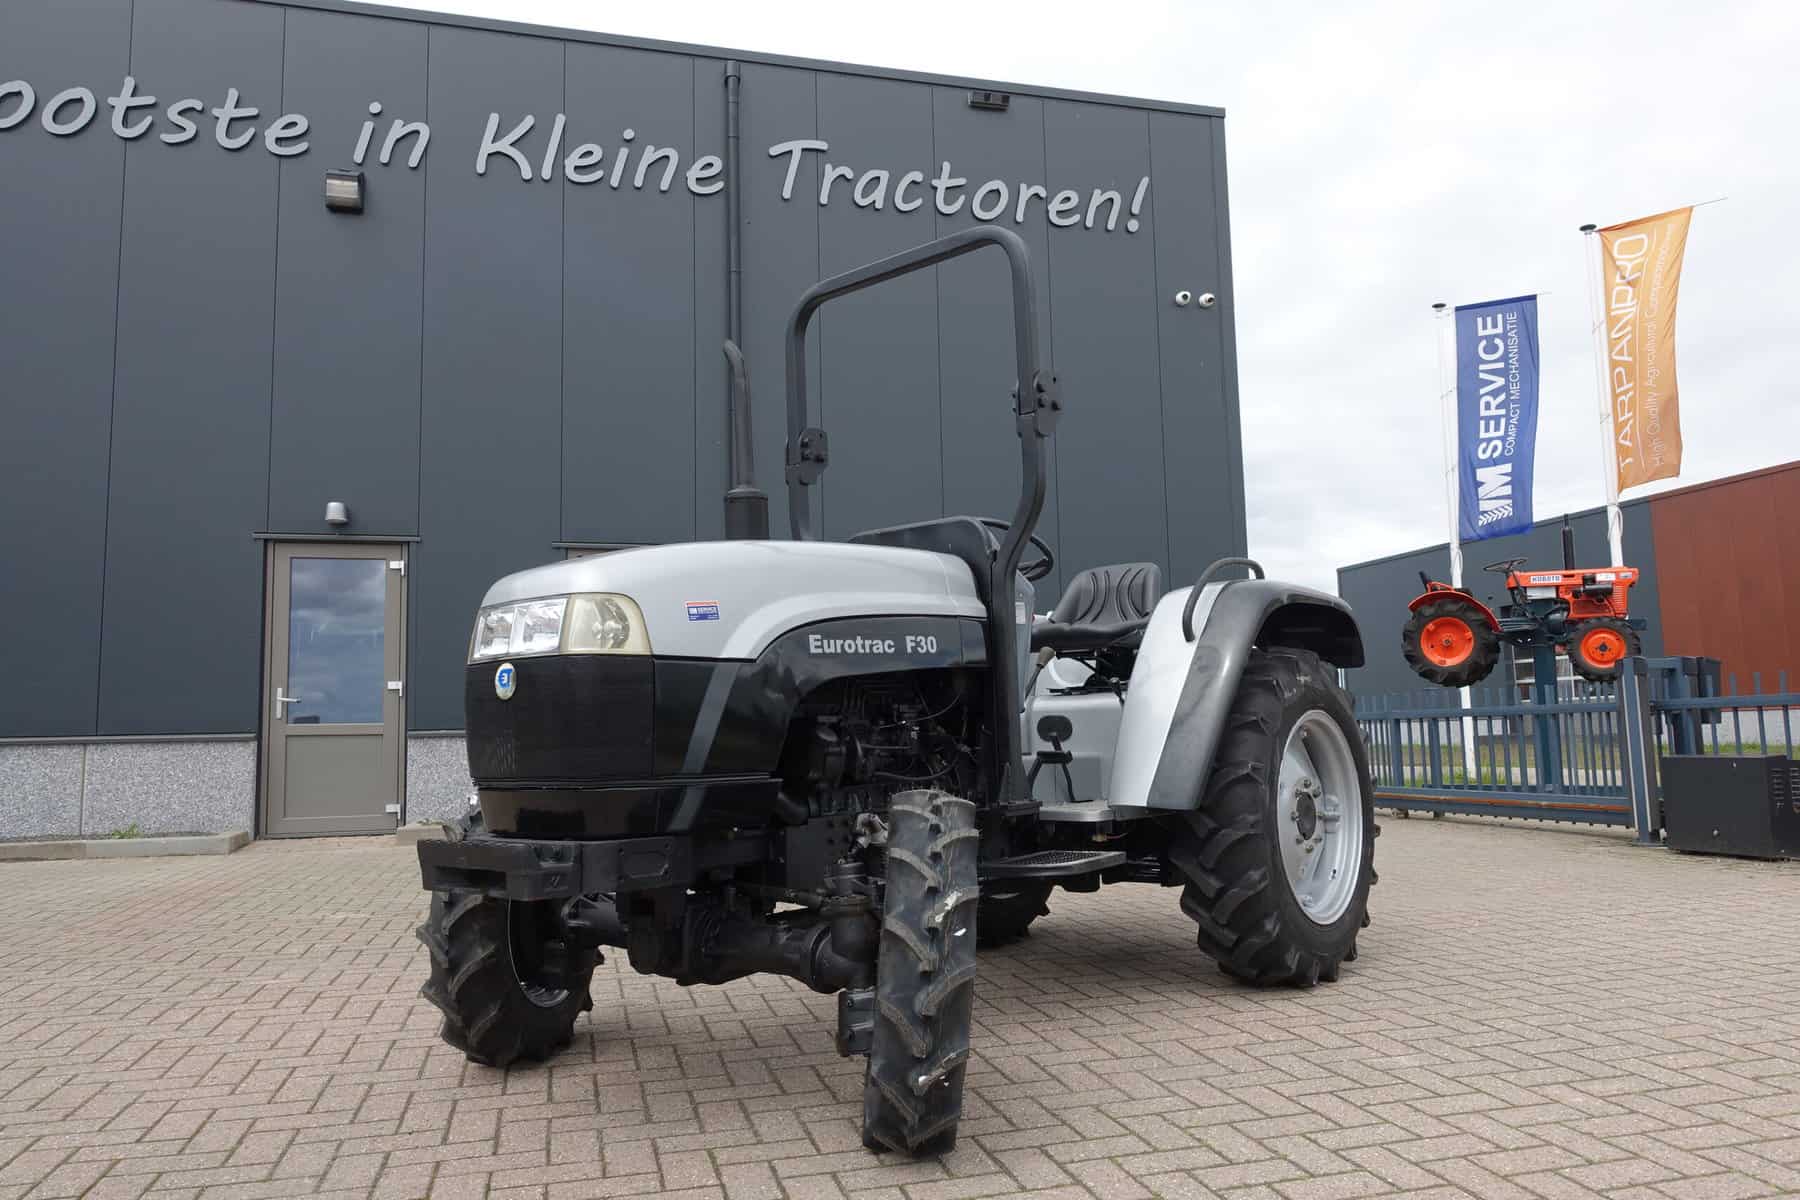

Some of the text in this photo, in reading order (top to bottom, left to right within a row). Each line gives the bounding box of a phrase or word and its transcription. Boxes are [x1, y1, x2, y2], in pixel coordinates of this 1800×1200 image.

[352, 102, 431, 168] in
[475, 112, 726, 194] Kleine
[768, 139, 1150, 234] Tractoren!
[1477, 313, 1506, 460] SERVICE
[1504, 311, 1521, 456] COMPACT MECHANISATIE
[808, 634, 938, 654] Eurotrac F30
